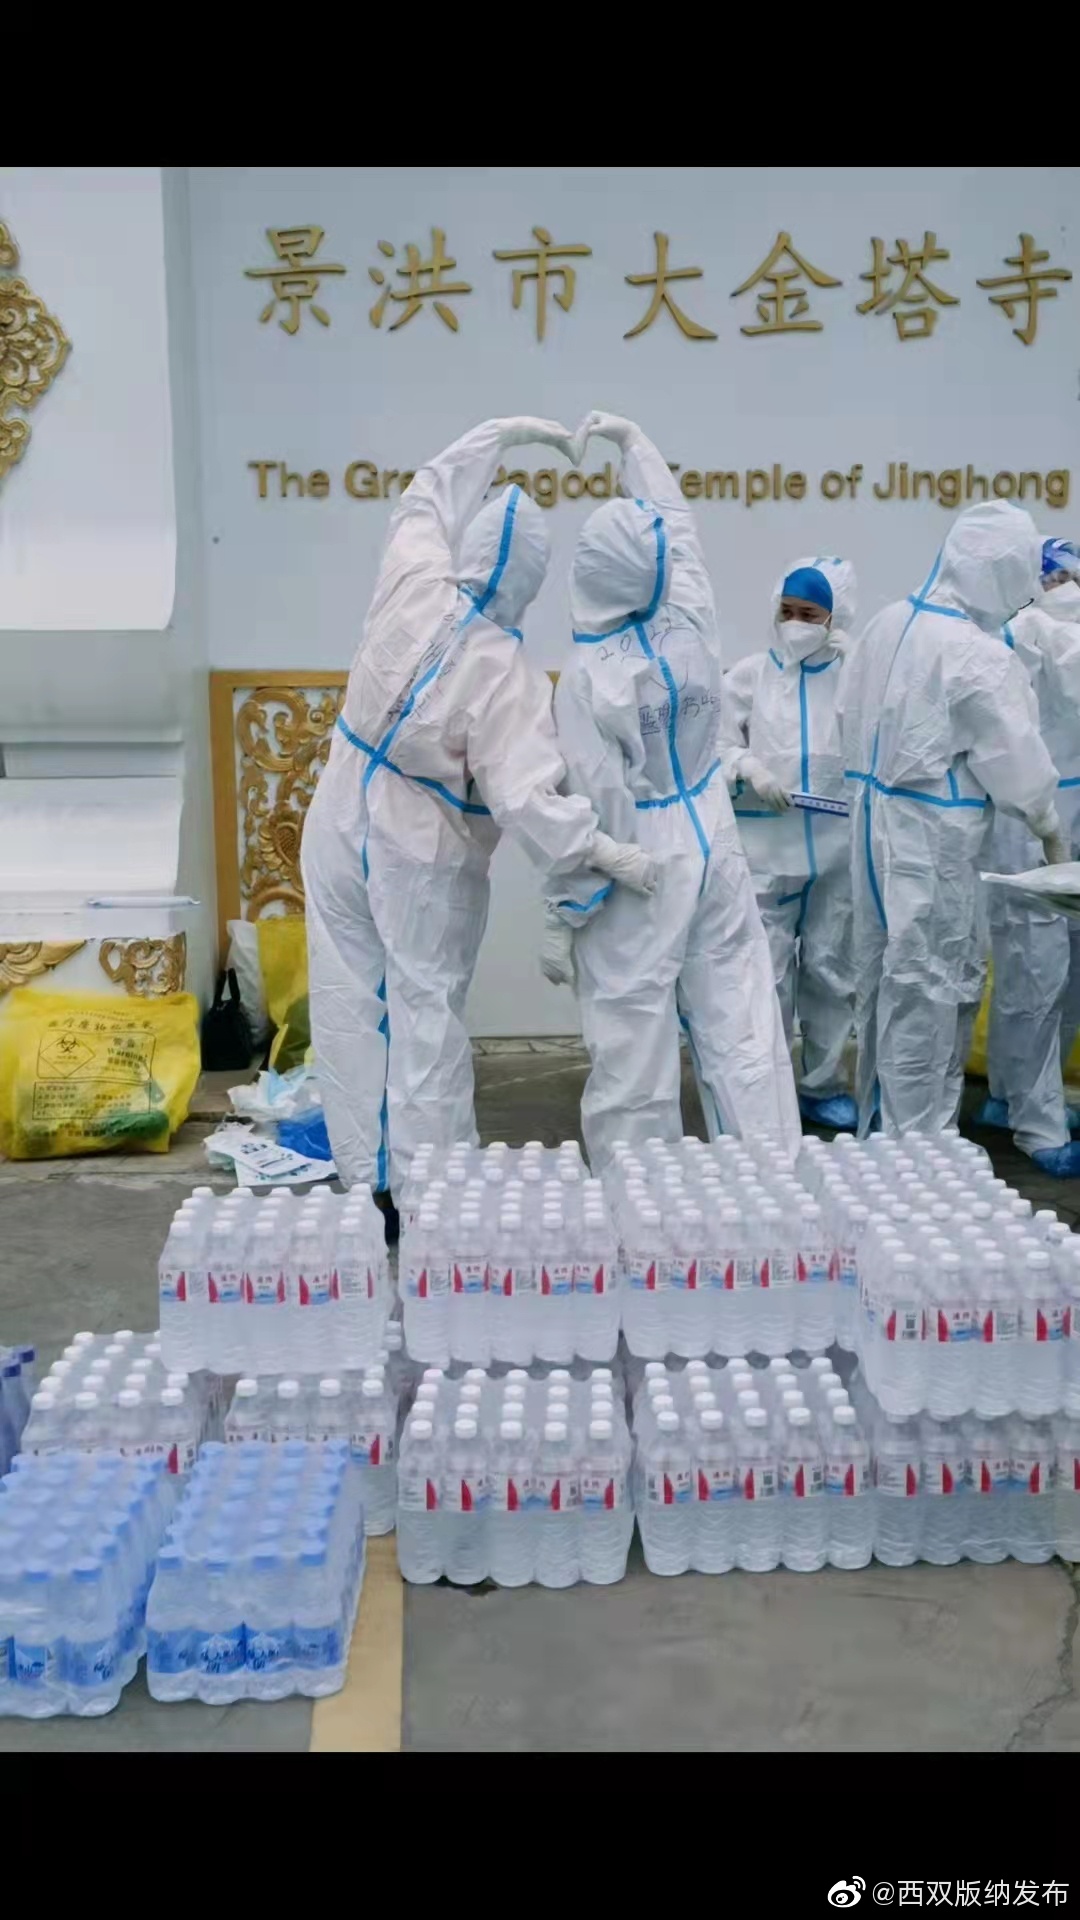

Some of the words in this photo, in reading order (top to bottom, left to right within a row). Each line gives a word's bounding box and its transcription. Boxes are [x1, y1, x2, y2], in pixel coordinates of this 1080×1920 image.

[244, 225, 1073, 345] 景洪市大金塔寺
[248, 460, 330, 498] The
[492, 462, 623, 508] agod
[820, 463, 863, 499] of
[873, 462, 1070, 509] Jinghong
